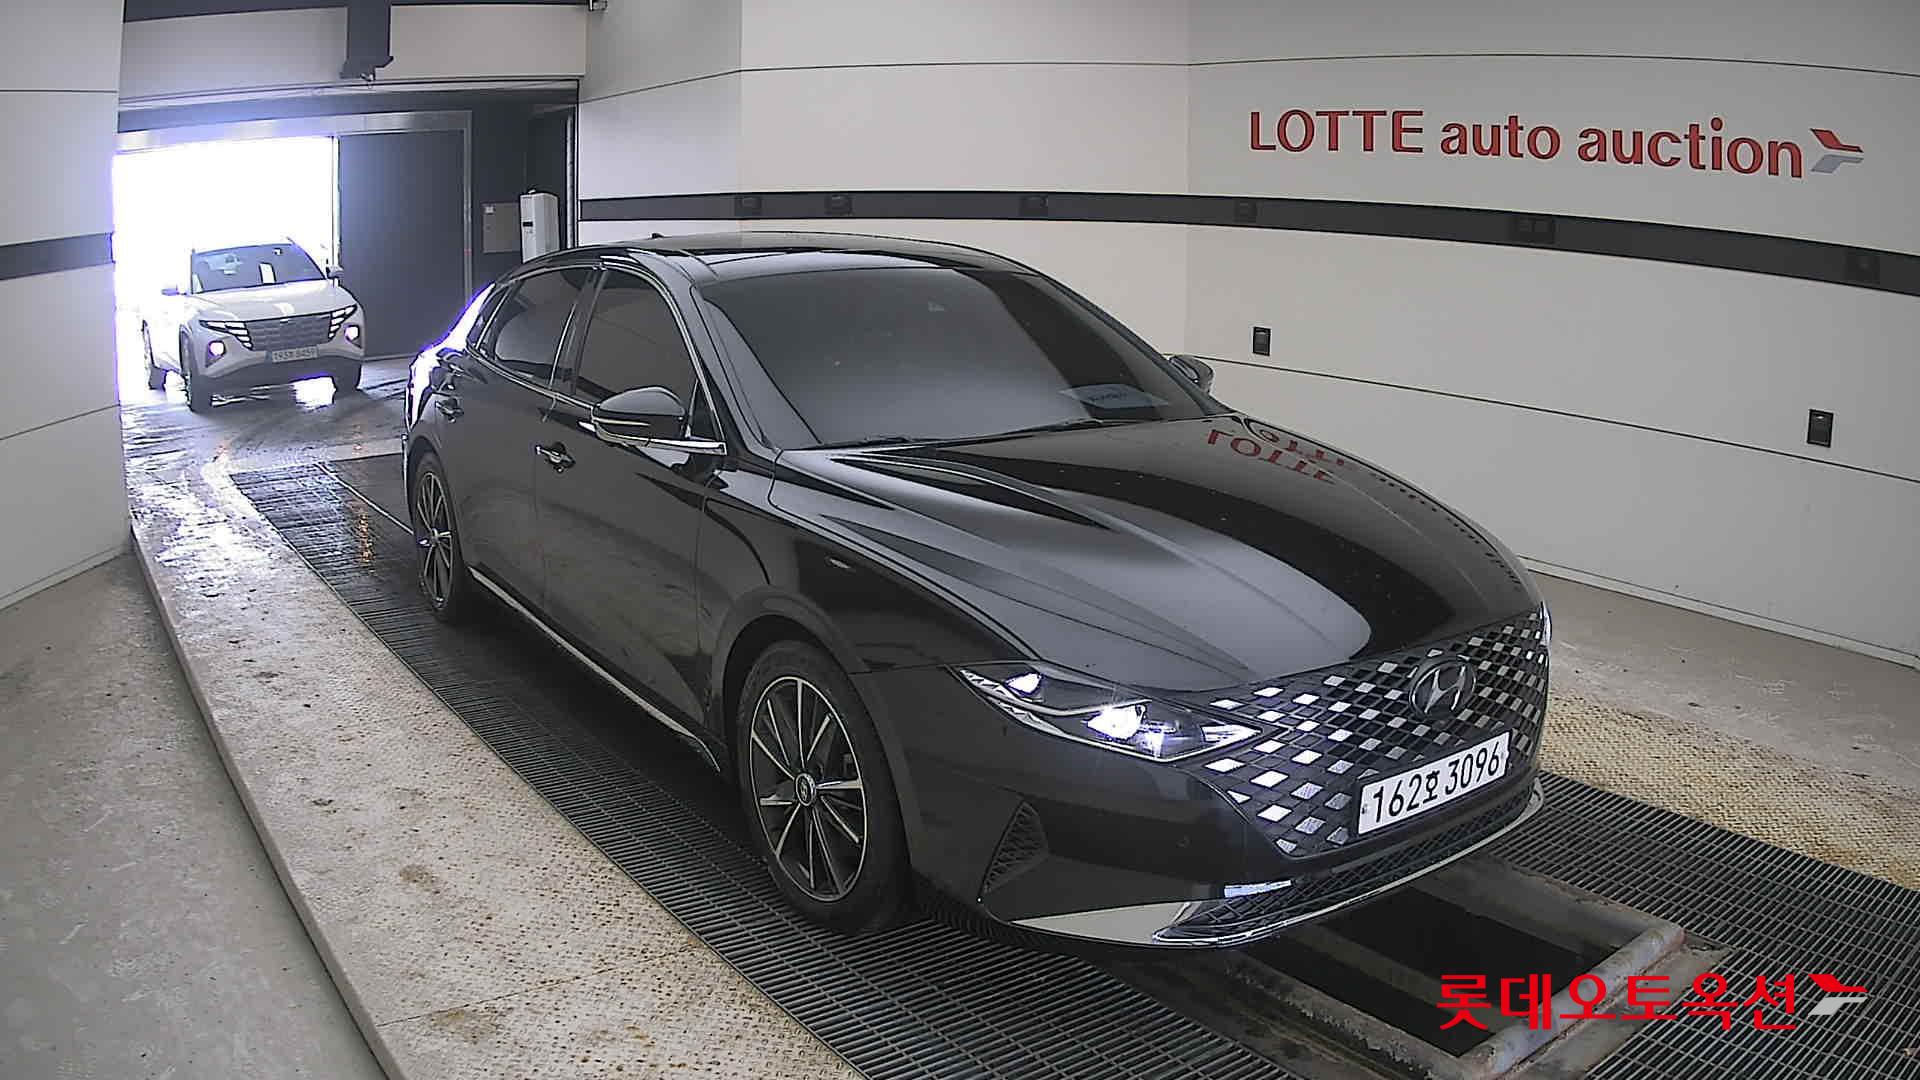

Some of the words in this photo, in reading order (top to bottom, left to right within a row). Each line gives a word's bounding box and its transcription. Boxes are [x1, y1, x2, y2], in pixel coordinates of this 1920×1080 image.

[1250, 110, 1424, 153] LOTTE
[1440, 115, 1561, 160] auto
[1576, 117, 1803, 178] auction
[1373, 770, 1440, 823] 162호
[1445, 741, 1500, 796] 3096
